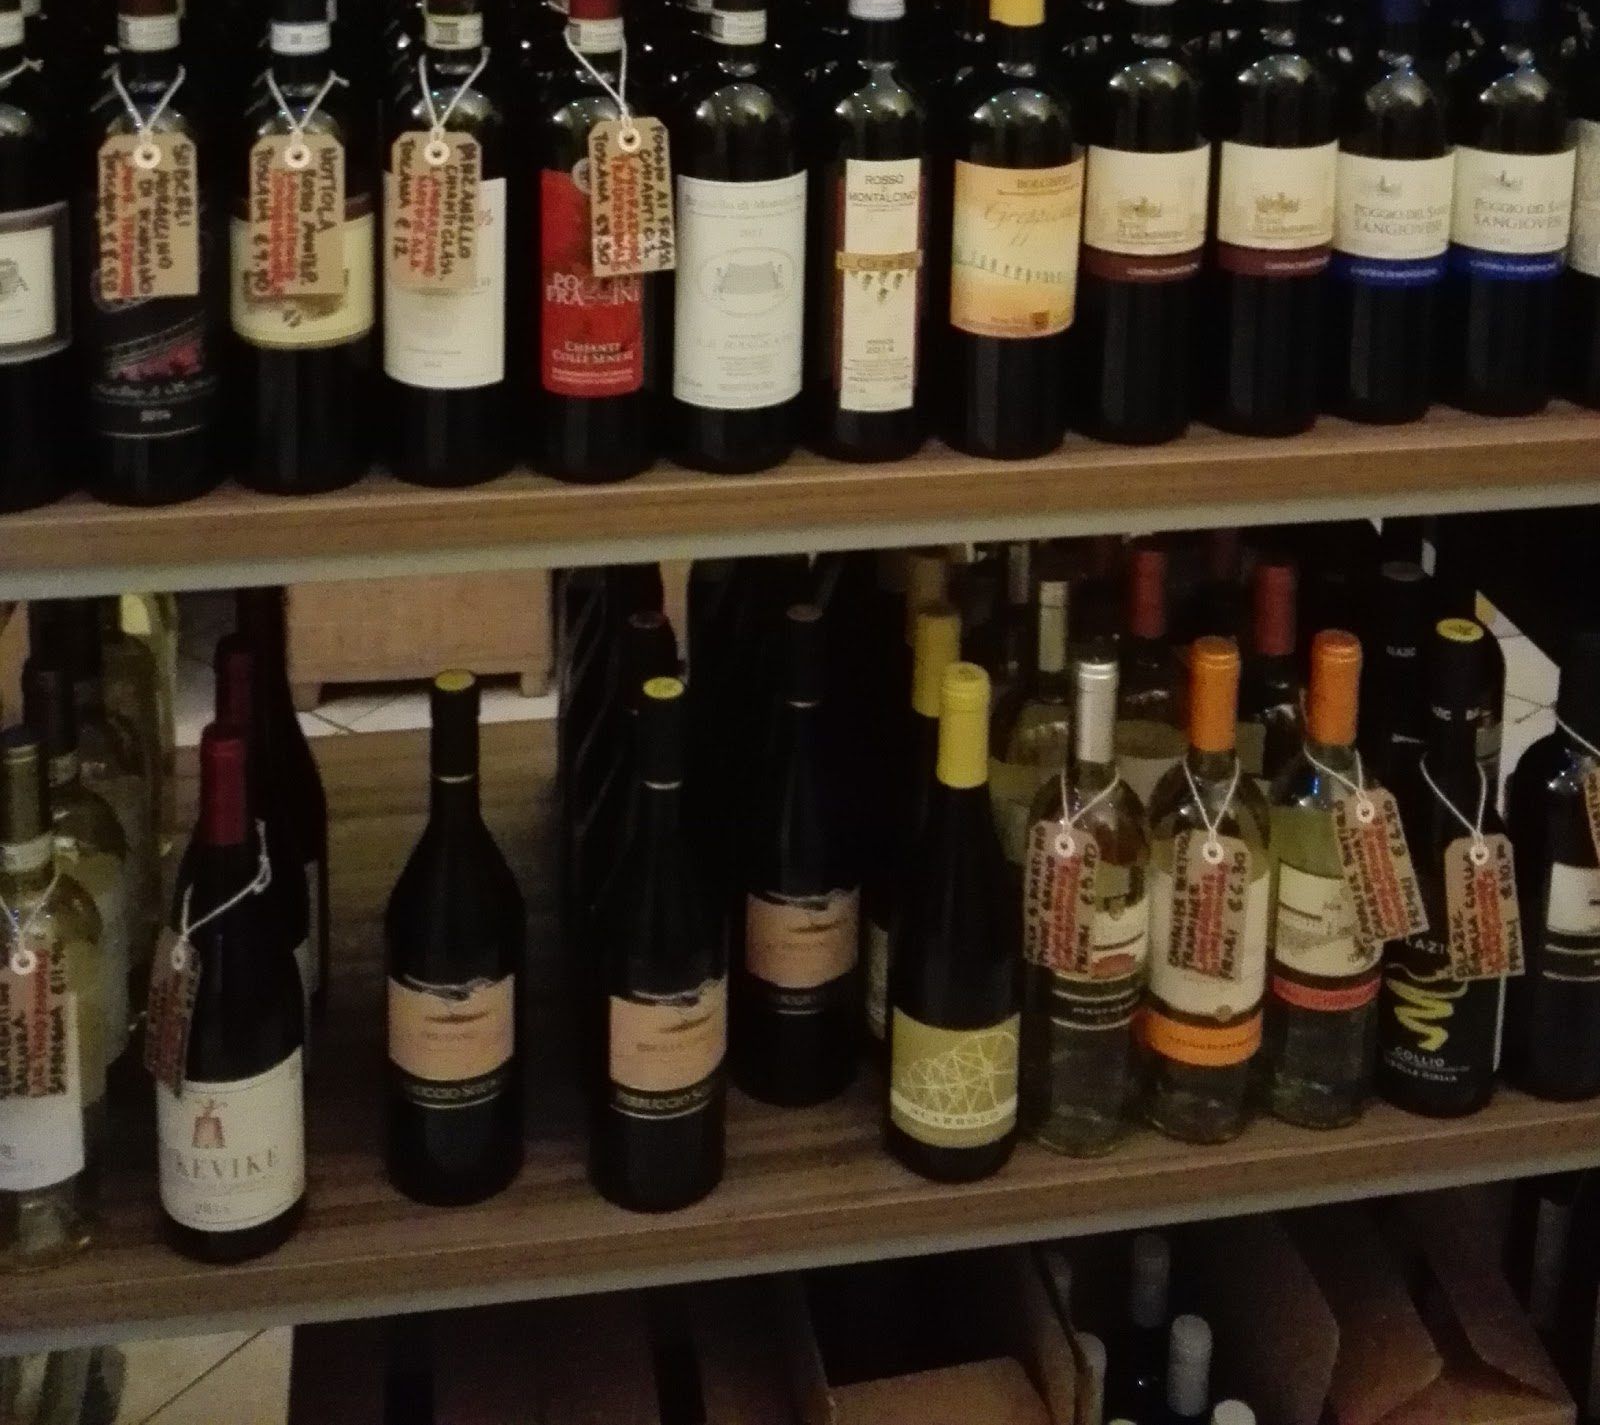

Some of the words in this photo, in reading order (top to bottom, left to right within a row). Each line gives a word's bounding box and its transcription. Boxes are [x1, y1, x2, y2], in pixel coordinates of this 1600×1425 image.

[315, 146, 336, 232] NOTTOLA
[593, 131, 609, 204] TOSCANA
[639, 148, 654, 223] CHIANTI
[865, 175, 904, 185] ROSSO
[849, 191, 918, 203] MONTALCINO
[1394, 1047, 1445, 1066] COLLIO
